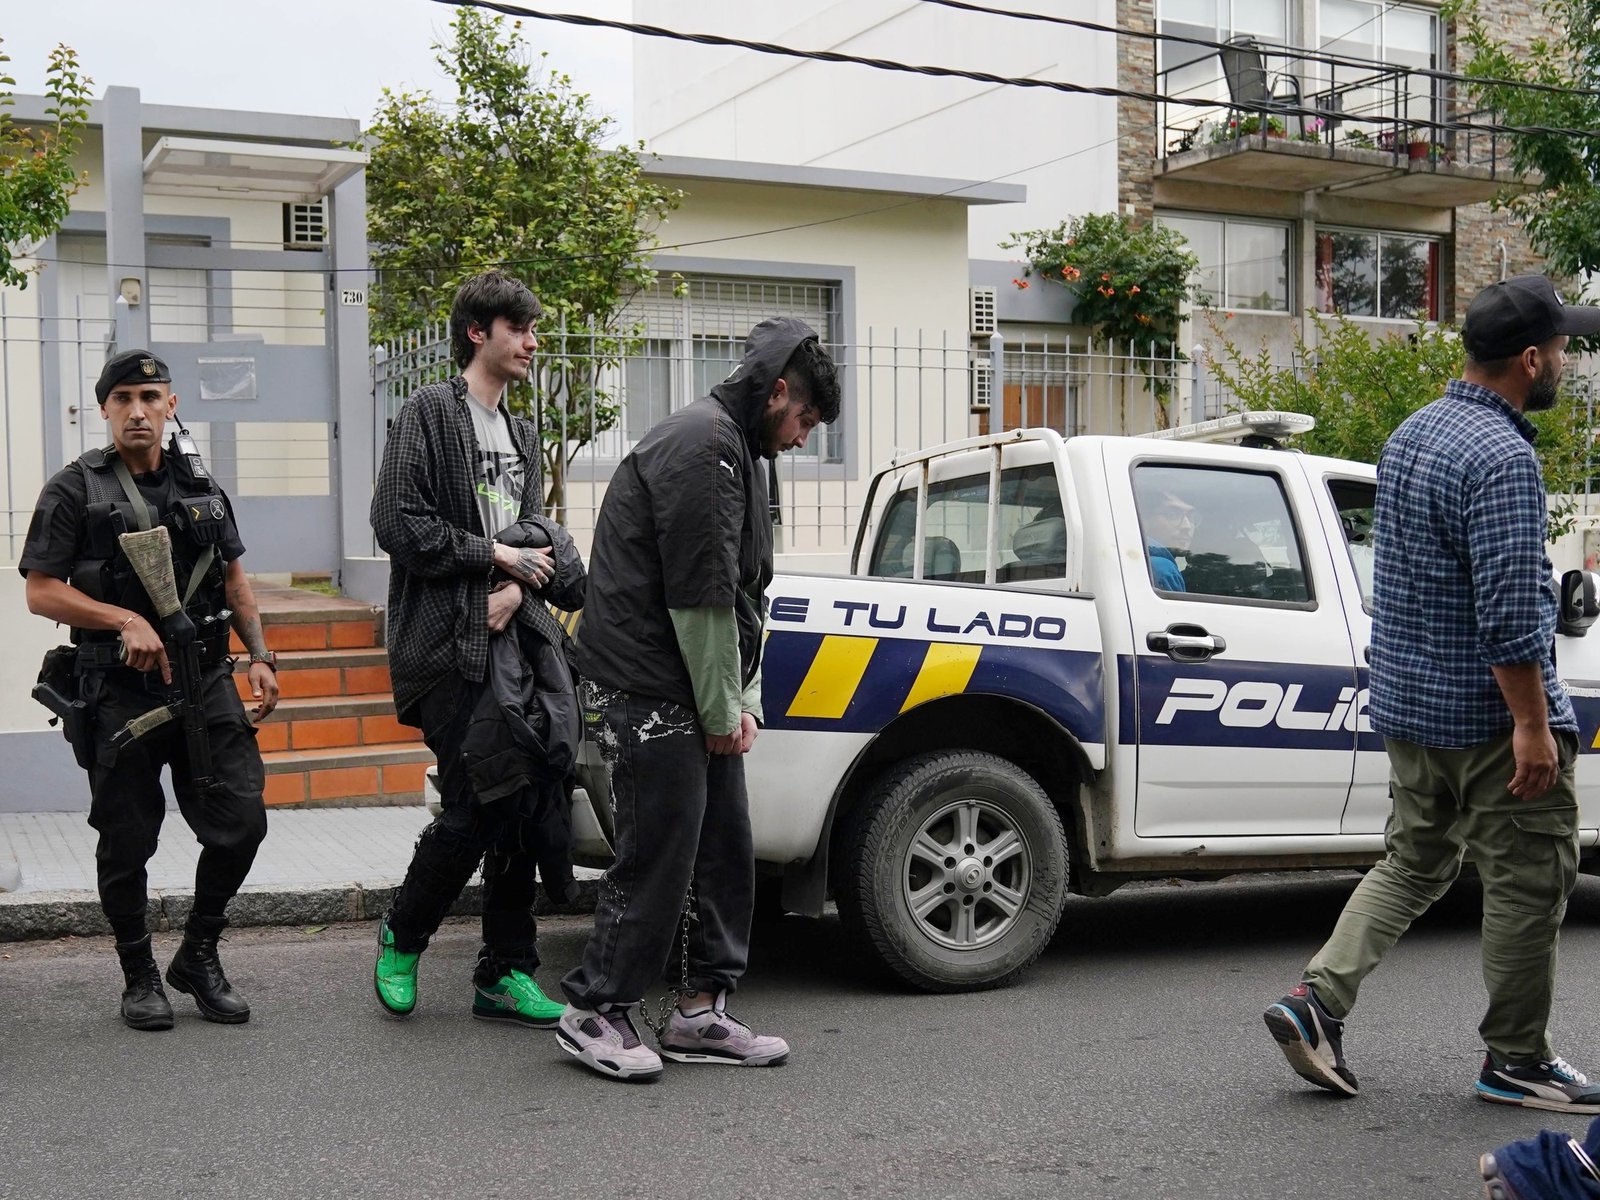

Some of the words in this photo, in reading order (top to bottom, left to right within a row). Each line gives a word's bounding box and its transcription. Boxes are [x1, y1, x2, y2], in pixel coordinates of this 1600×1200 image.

[343, 291, 363, 304] 730
[833, 600, 907, 630] TU
[926, 607, 1067, 641] LADO
